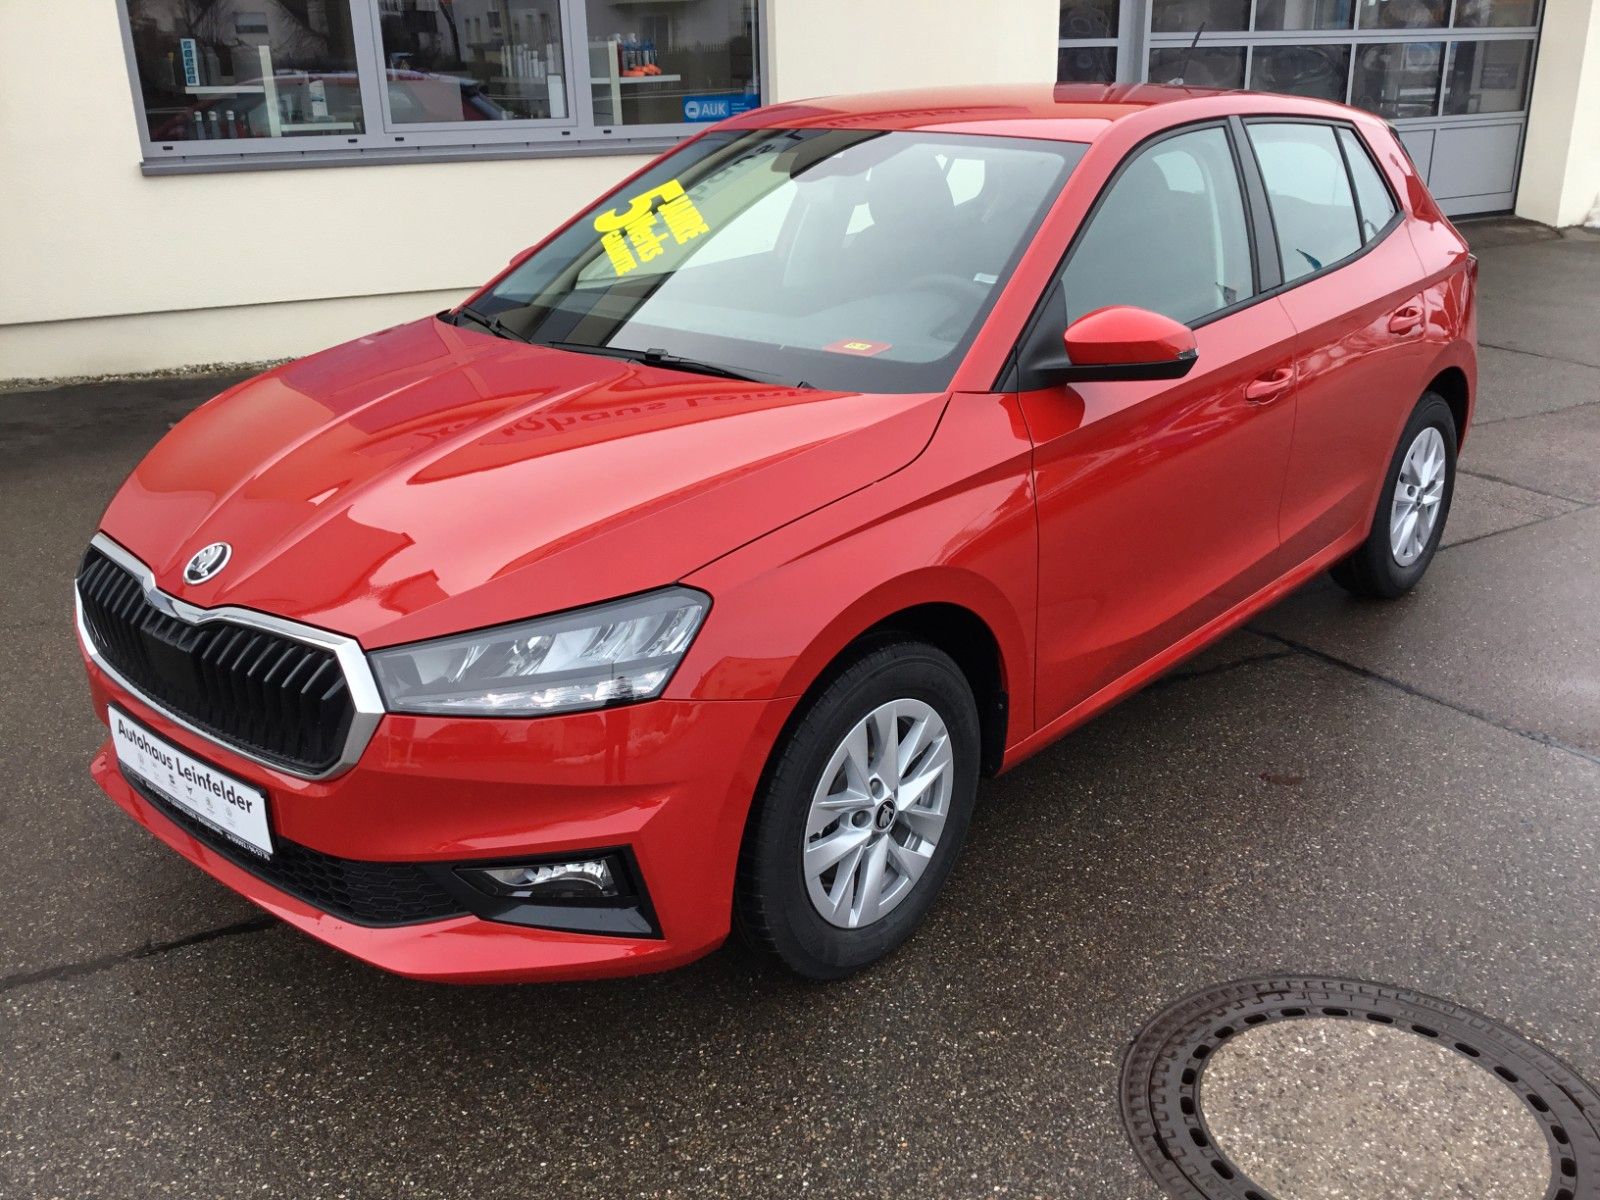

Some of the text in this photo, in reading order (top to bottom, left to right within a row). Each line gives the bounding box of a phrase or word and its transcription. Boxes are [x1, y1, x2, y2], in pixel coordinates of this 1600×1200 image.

[701, 102, 727, 116] AUK
[594, 179, 685, 232] 5
[657, 194, 710, 245] JAHRE
[118, 719, 173, 770] Autohaus
[176, 757, 253, 814] Leinfelder
